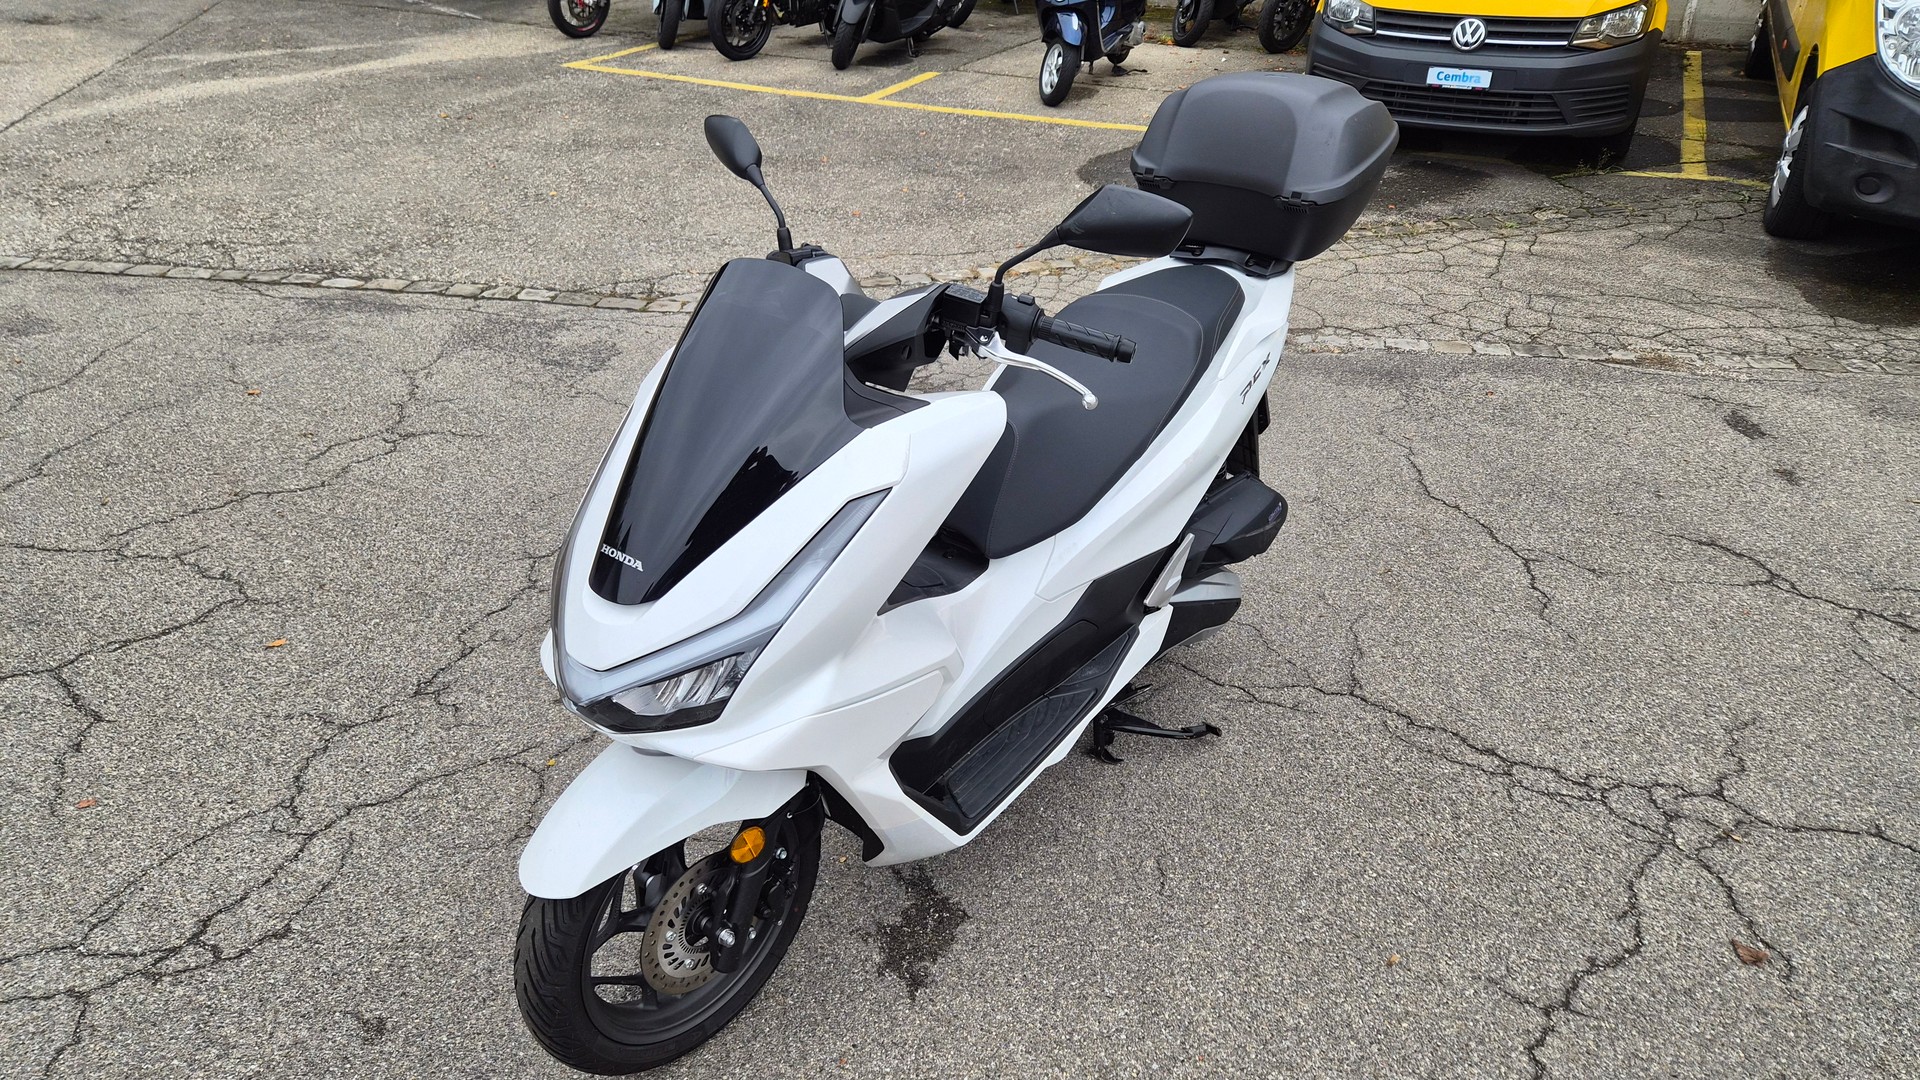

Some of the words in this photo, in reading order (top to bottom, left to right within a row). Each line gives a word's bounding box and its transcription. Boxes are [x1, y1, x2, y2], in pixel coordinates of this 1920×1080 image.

[1436, 71, 1482, 84] Cembra
[1240, 352, 1271, 405] PCX
[600, 544, 644, 572] HONDA
